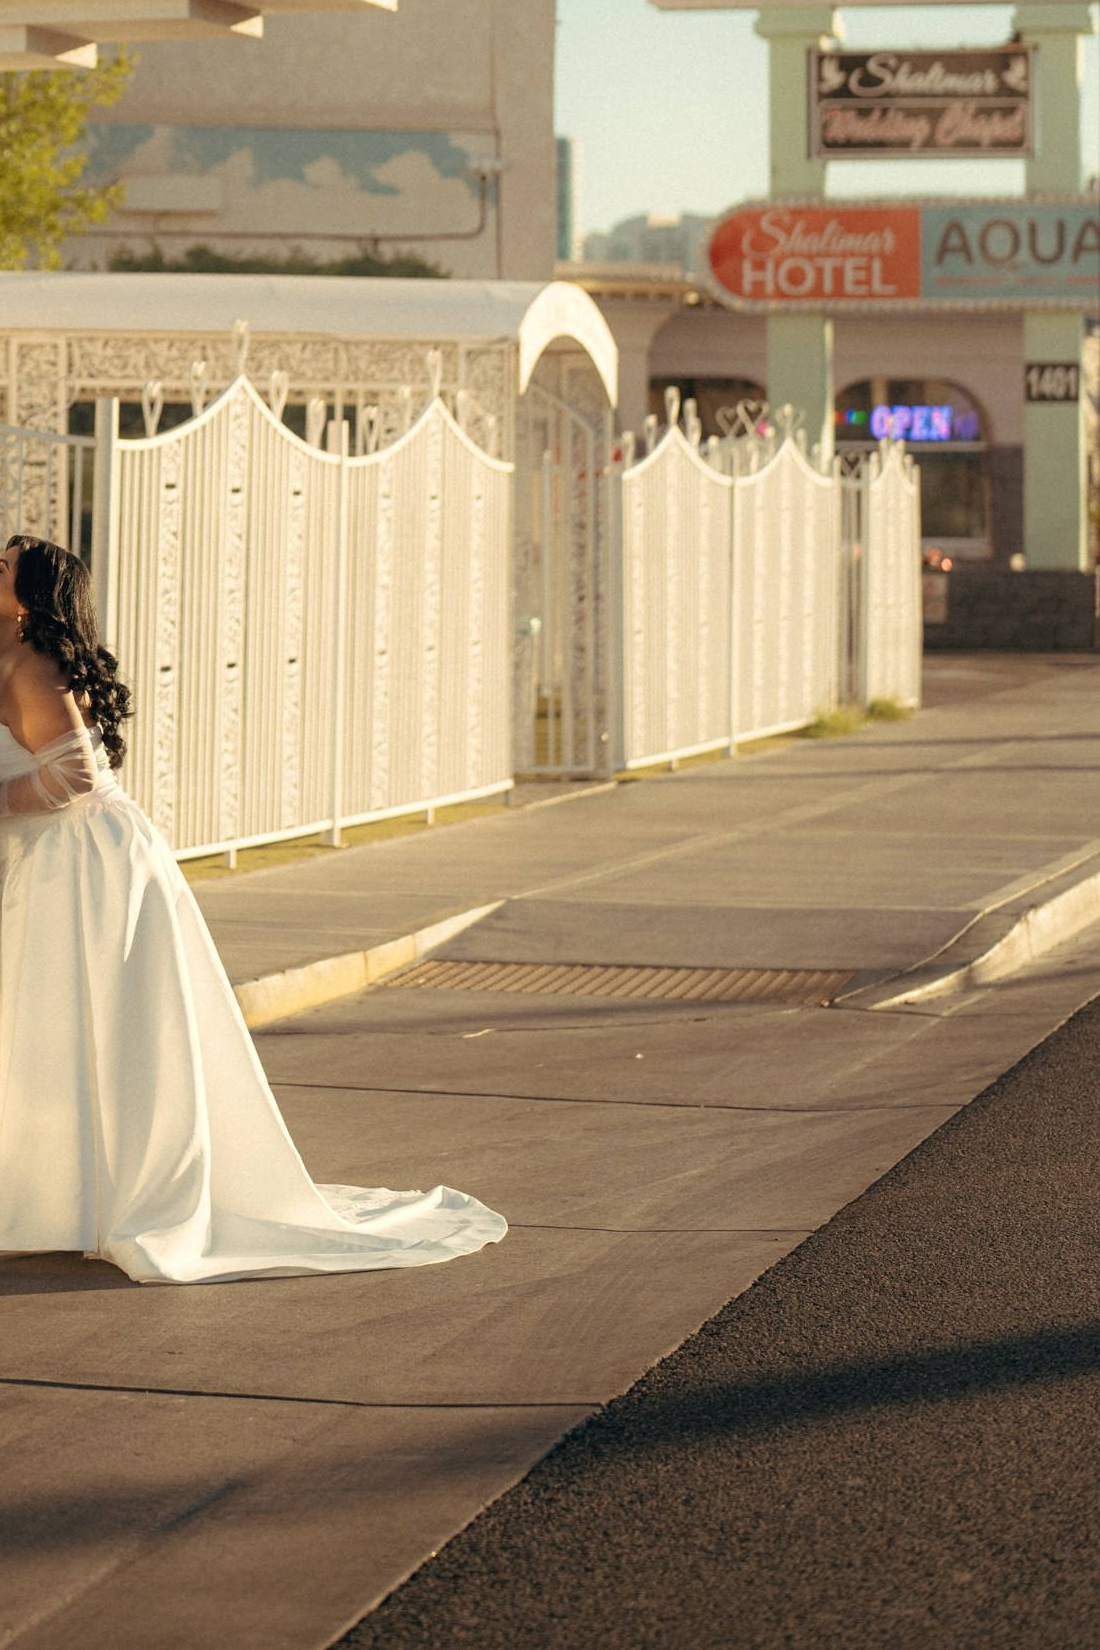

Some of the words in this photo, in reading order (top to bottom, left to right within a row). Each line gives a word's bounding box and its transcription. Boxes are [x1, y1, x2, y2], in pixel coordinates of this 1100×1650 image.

[848, 53, 998, 98] Shalimar
[741, 211, 896, 257] Shalimar
[741, 257, 897, 295] HOTEL
[1027, 365, 1078, 399] 1401
[870, 405, 953, 441] OPEN
